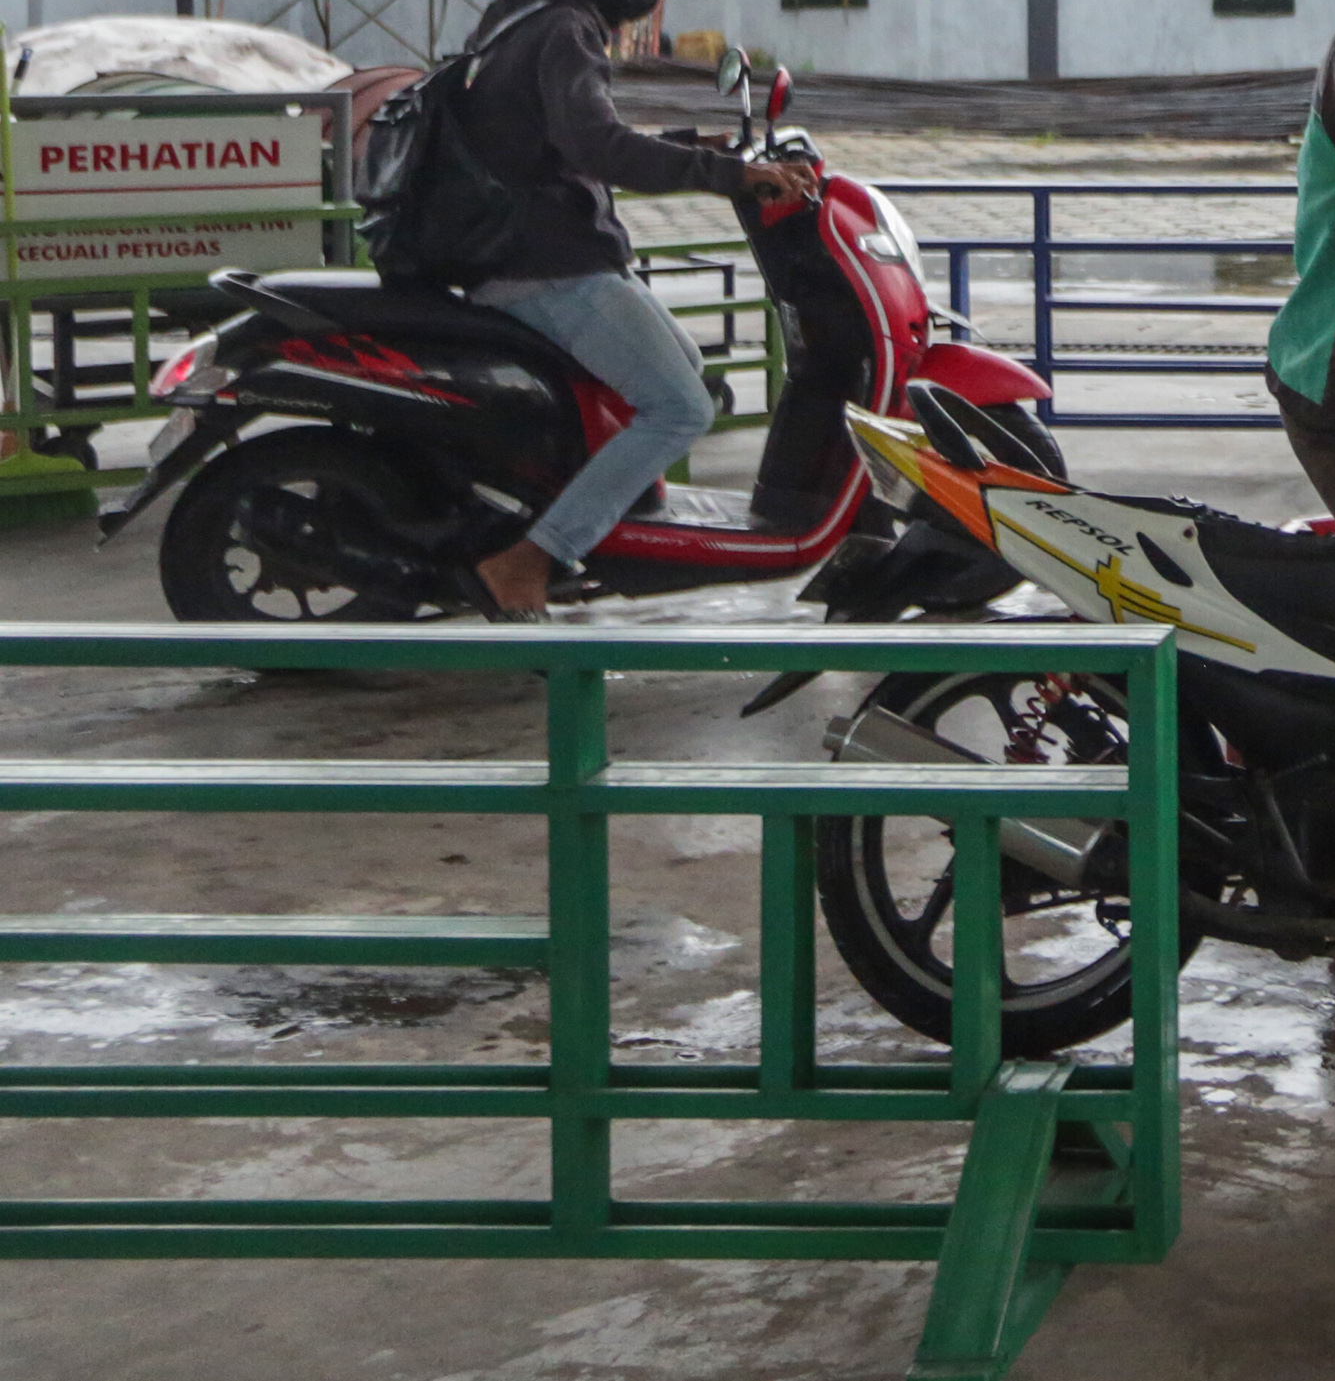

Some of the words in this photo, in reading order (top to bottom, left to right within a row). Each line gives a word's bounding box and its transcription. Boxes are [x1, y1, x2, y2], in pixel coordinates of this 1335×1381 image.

[40, 139, 281, 174] PERHATIAN
[117, 240, 221, 259] PETUGAS
[1025, 500, 1135, 556] REPSOL
